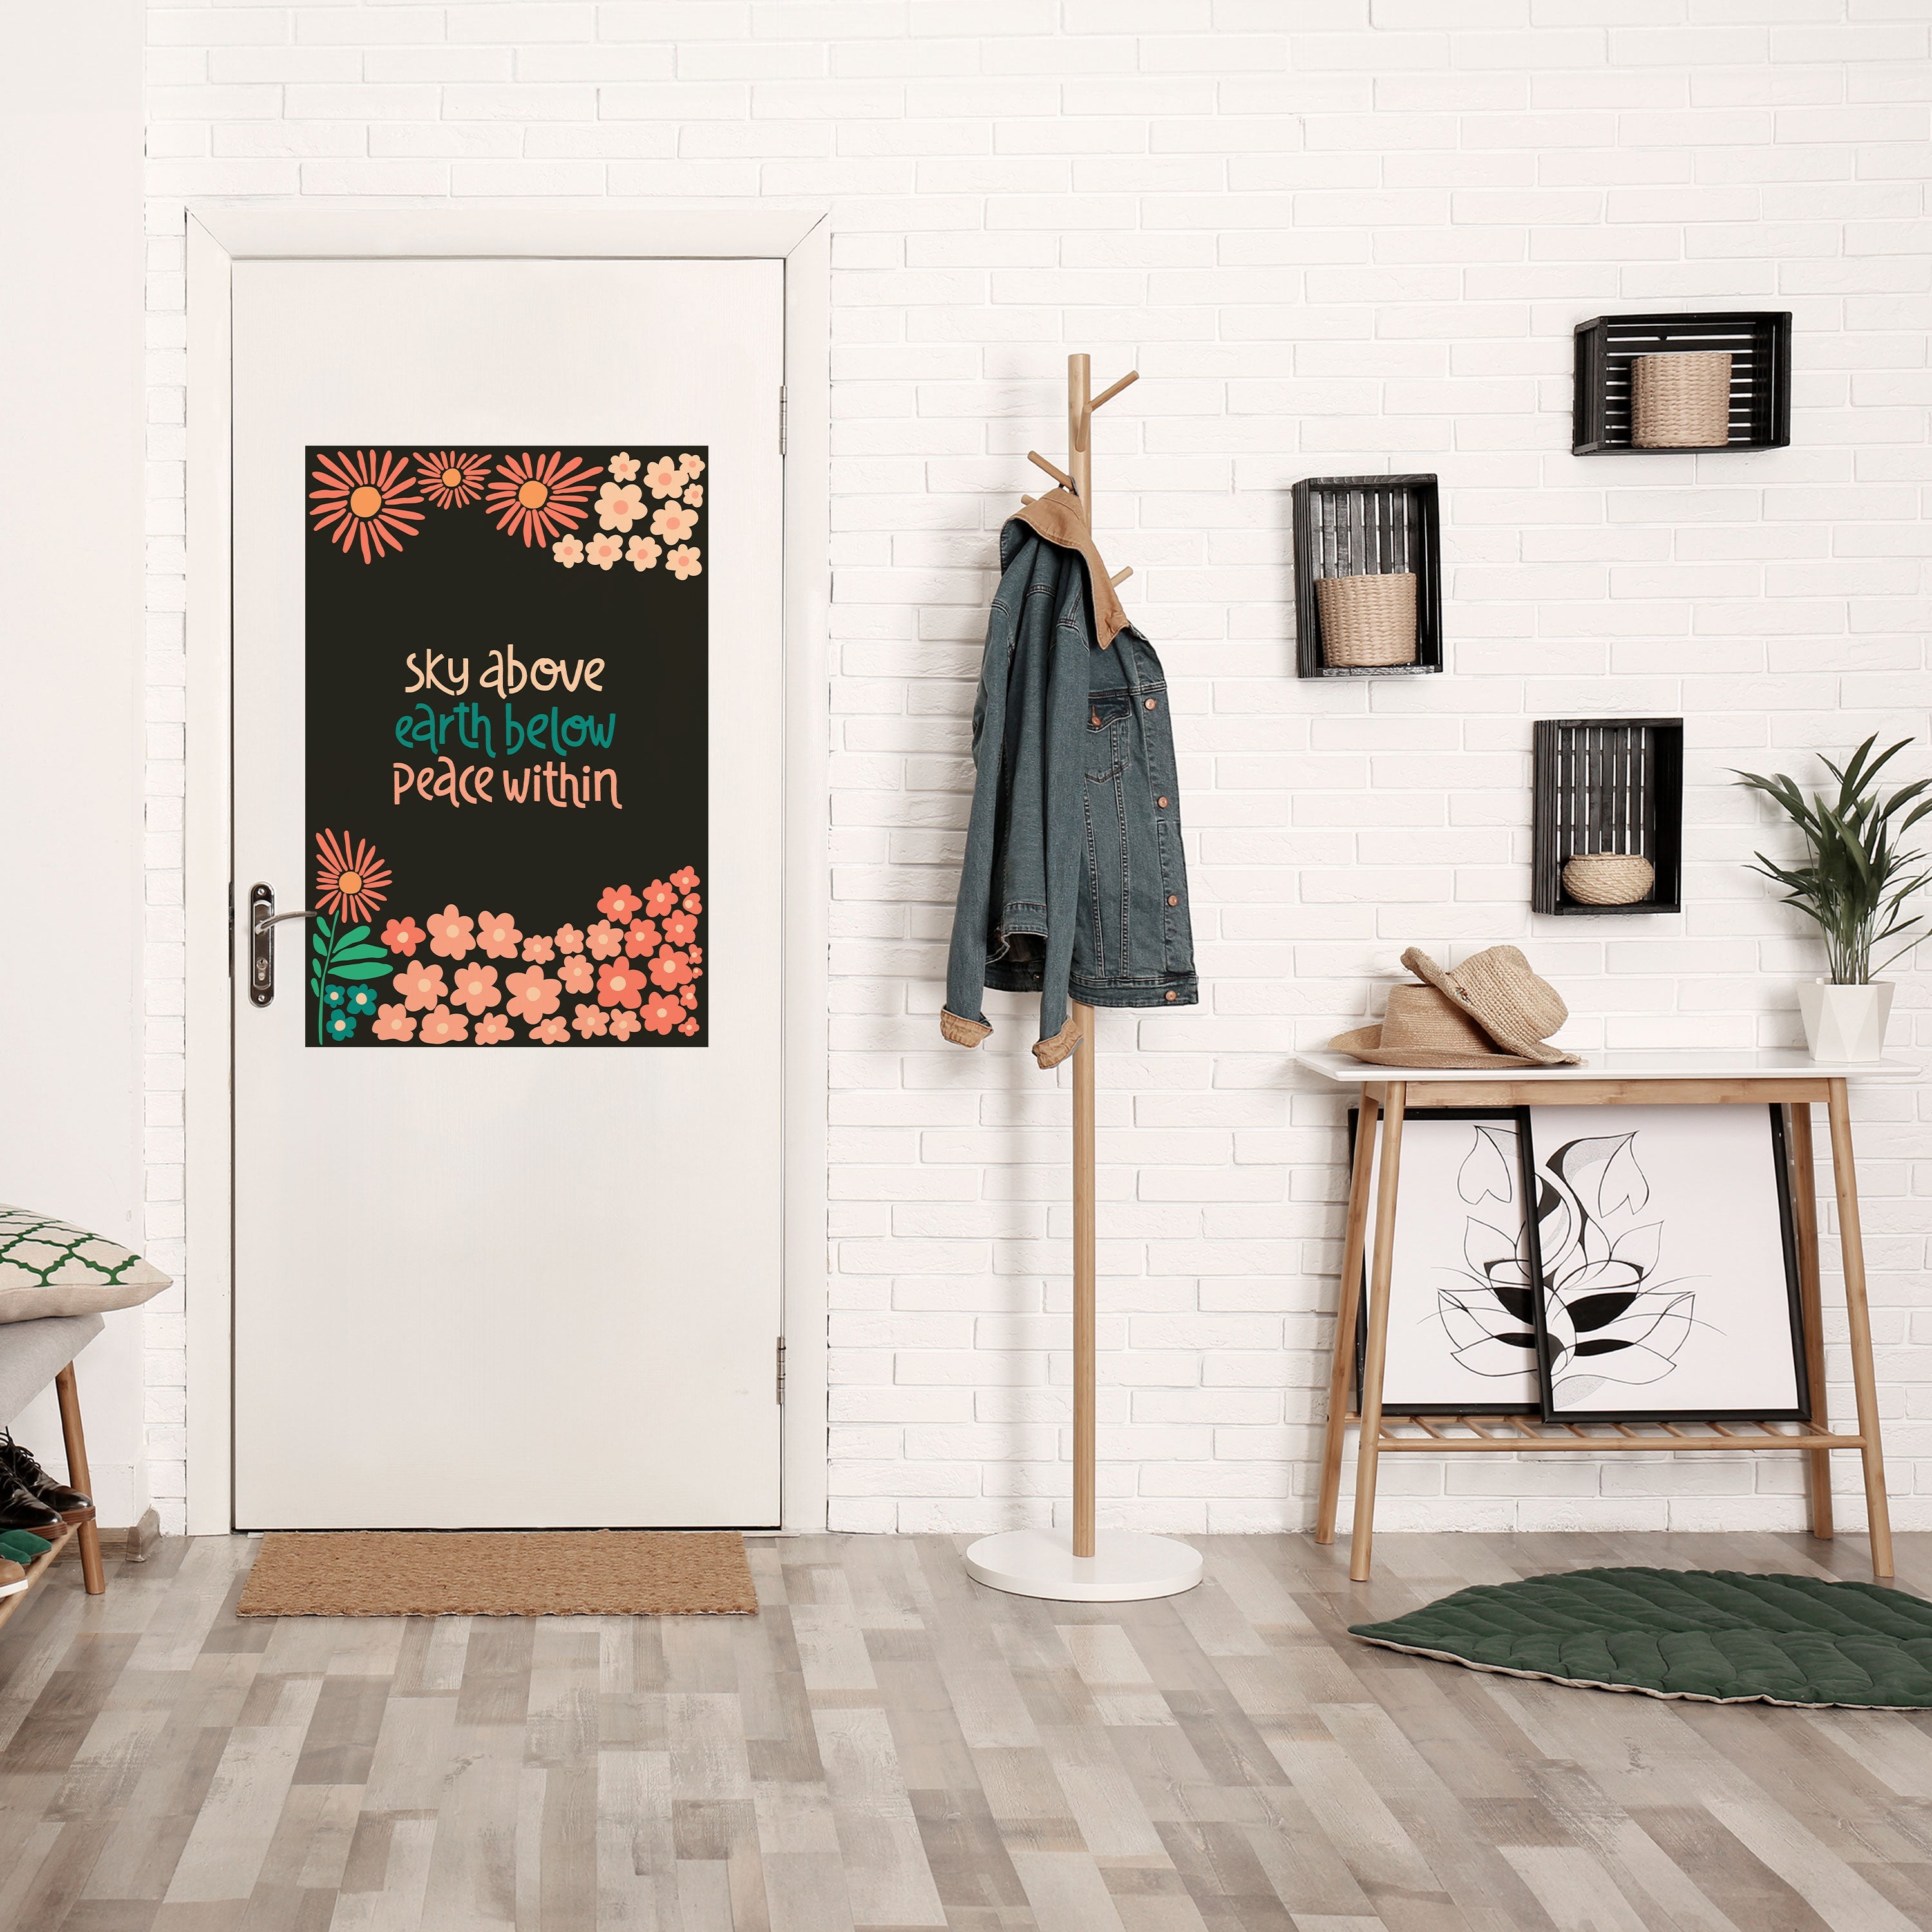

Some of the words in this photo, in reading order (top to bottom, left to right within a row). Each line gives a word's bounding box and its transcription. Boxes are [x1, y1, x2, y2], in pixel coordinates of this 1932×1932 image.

[405, 649, 469, 696] sky
[480, 644, 605, 699] above
[395, 703, 496, 758] earth
[506, 703, 616, 756] below
[503, 761, 622, 809] within
